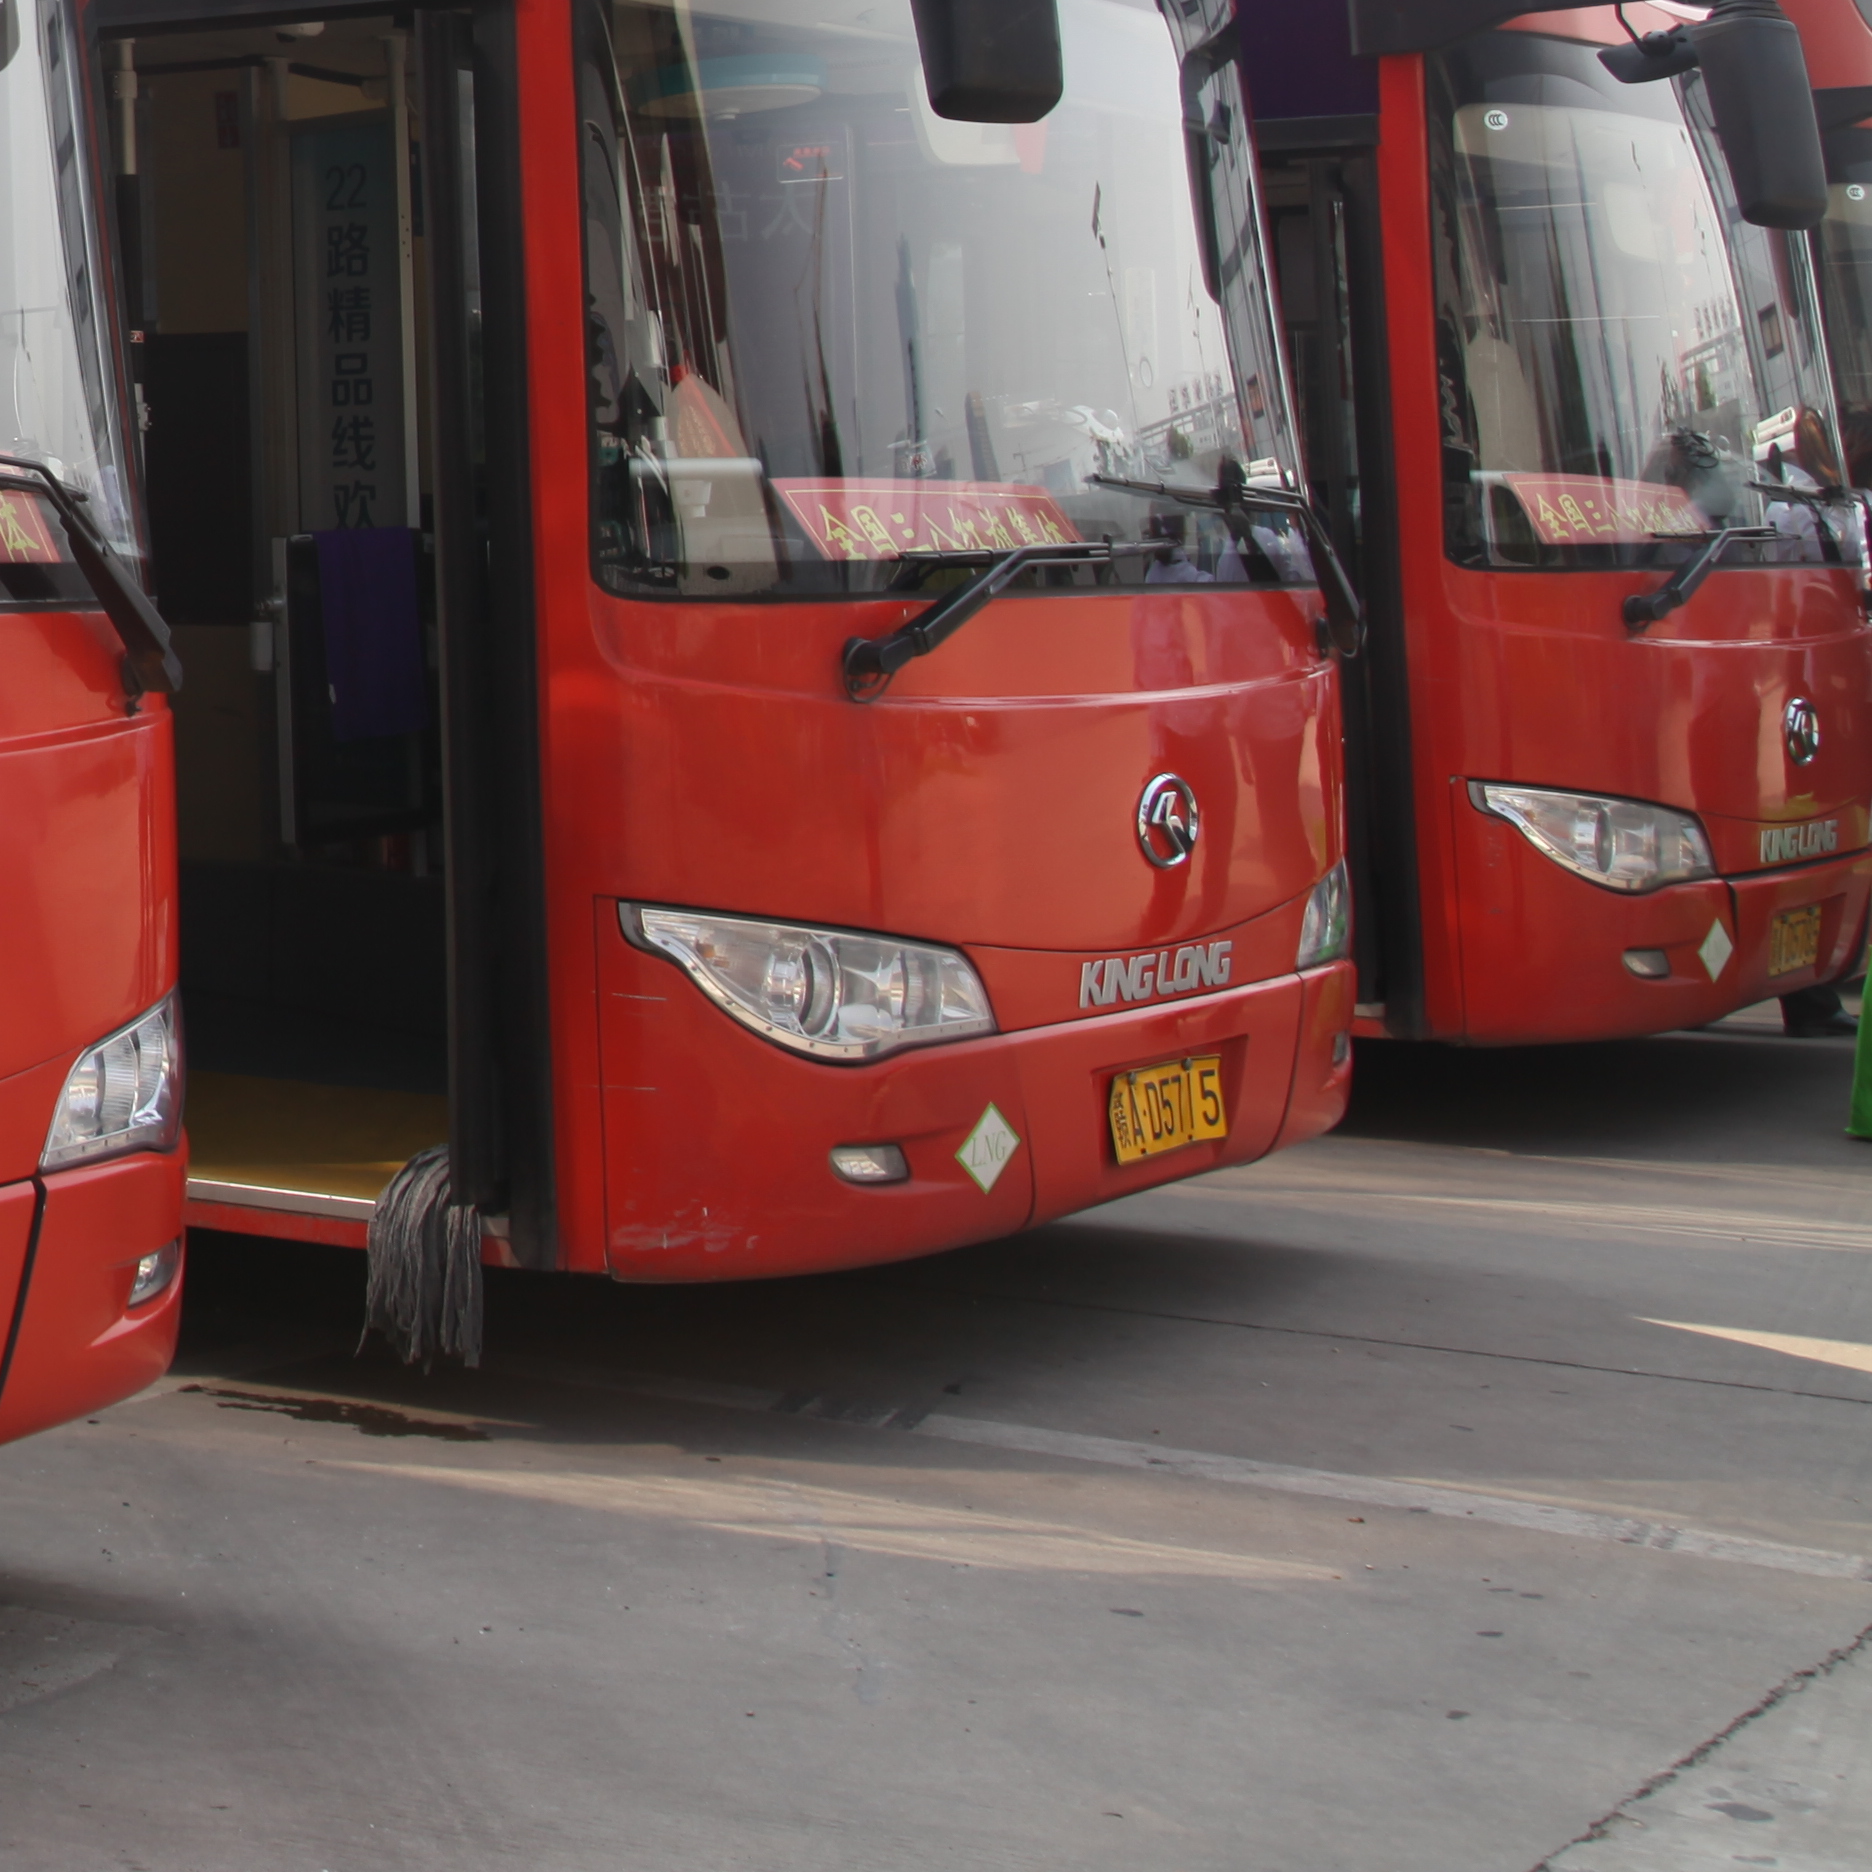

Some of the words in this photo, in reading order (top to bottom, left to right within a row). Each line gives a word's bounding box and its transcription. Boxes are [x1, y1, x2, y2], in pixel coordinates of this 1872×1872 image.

[1078, 954, 1154, 1009] KING
[1157, 939, 1233, 995] LONG
[970, 1123, 1008, 1169] LNG
